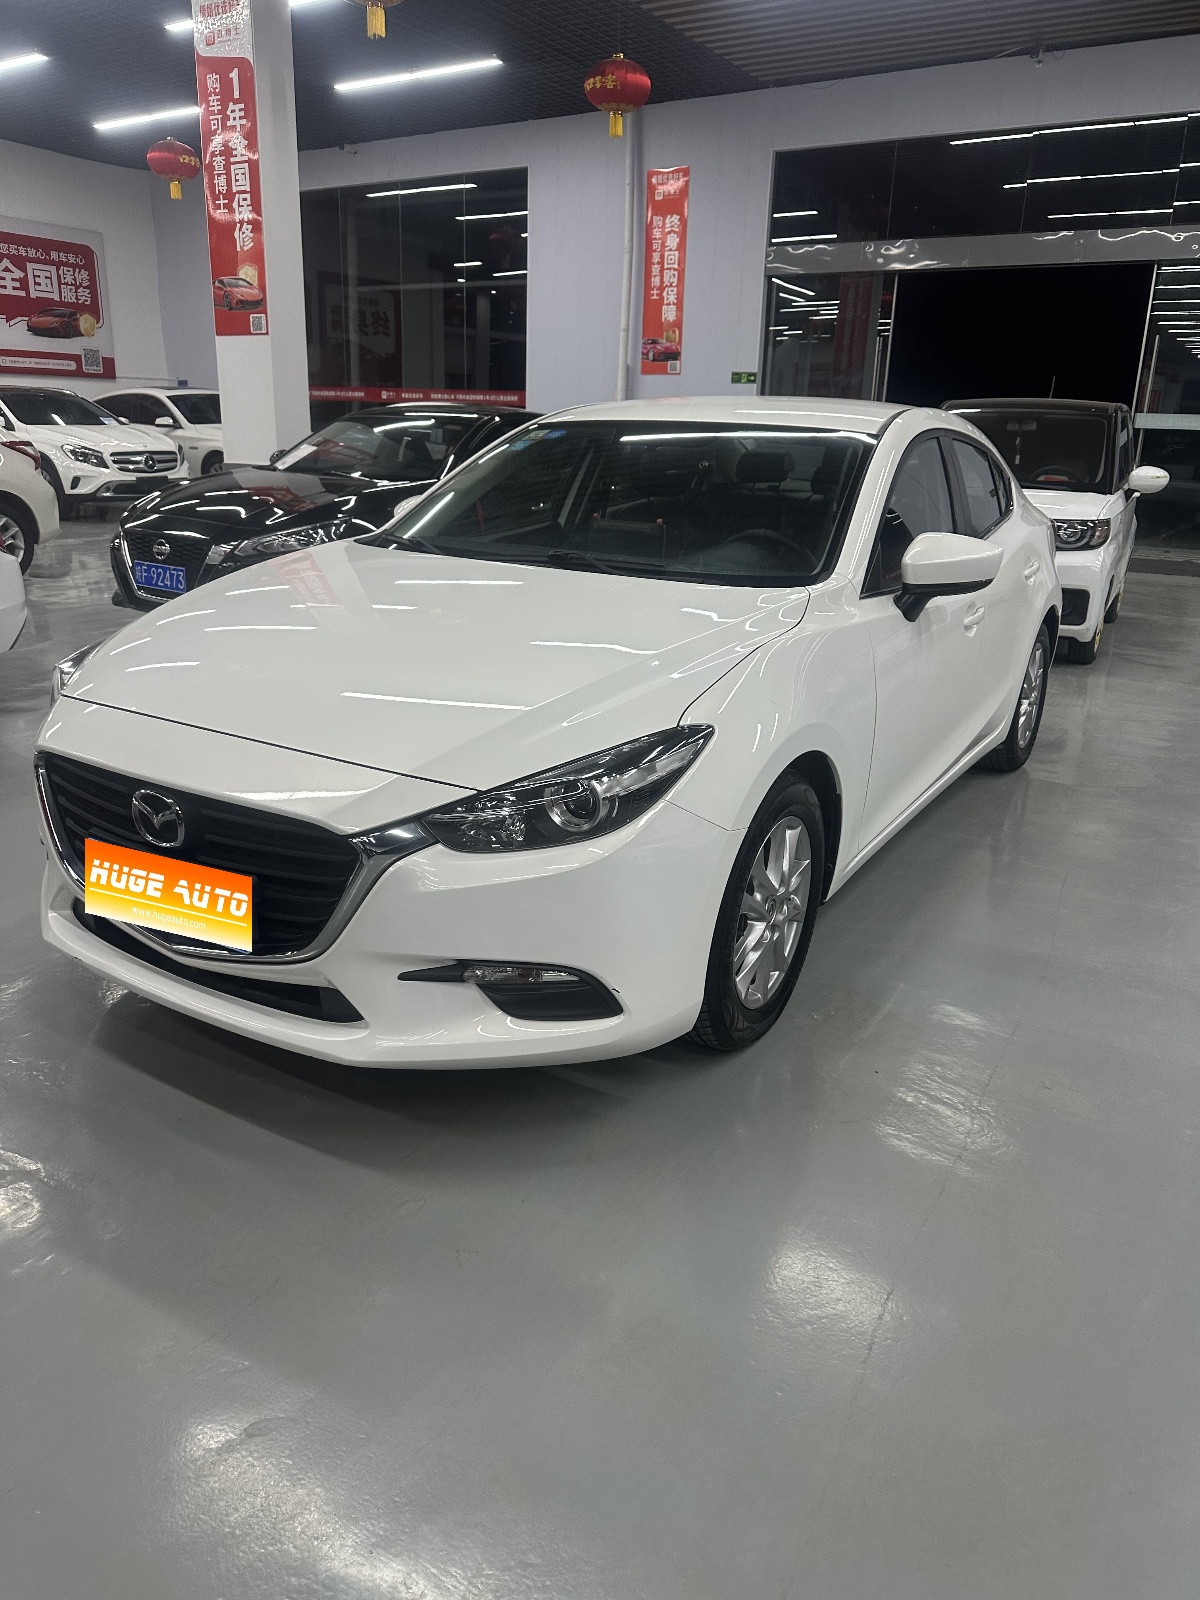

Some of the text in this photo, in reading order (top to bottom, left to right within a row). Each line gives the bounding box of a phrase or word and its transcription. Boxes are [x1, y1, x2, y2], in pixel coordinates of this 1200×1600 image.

[206, 72, 229, 213] 购车可享查博士
[227, 67, 254, 252] 1年全国保修
[0, 242, 85, 265] 您买车放心、用车安心
[651, 215, 663, 299] 购车可享查博士
[662, 214, 680, 322] 终身回购保障
